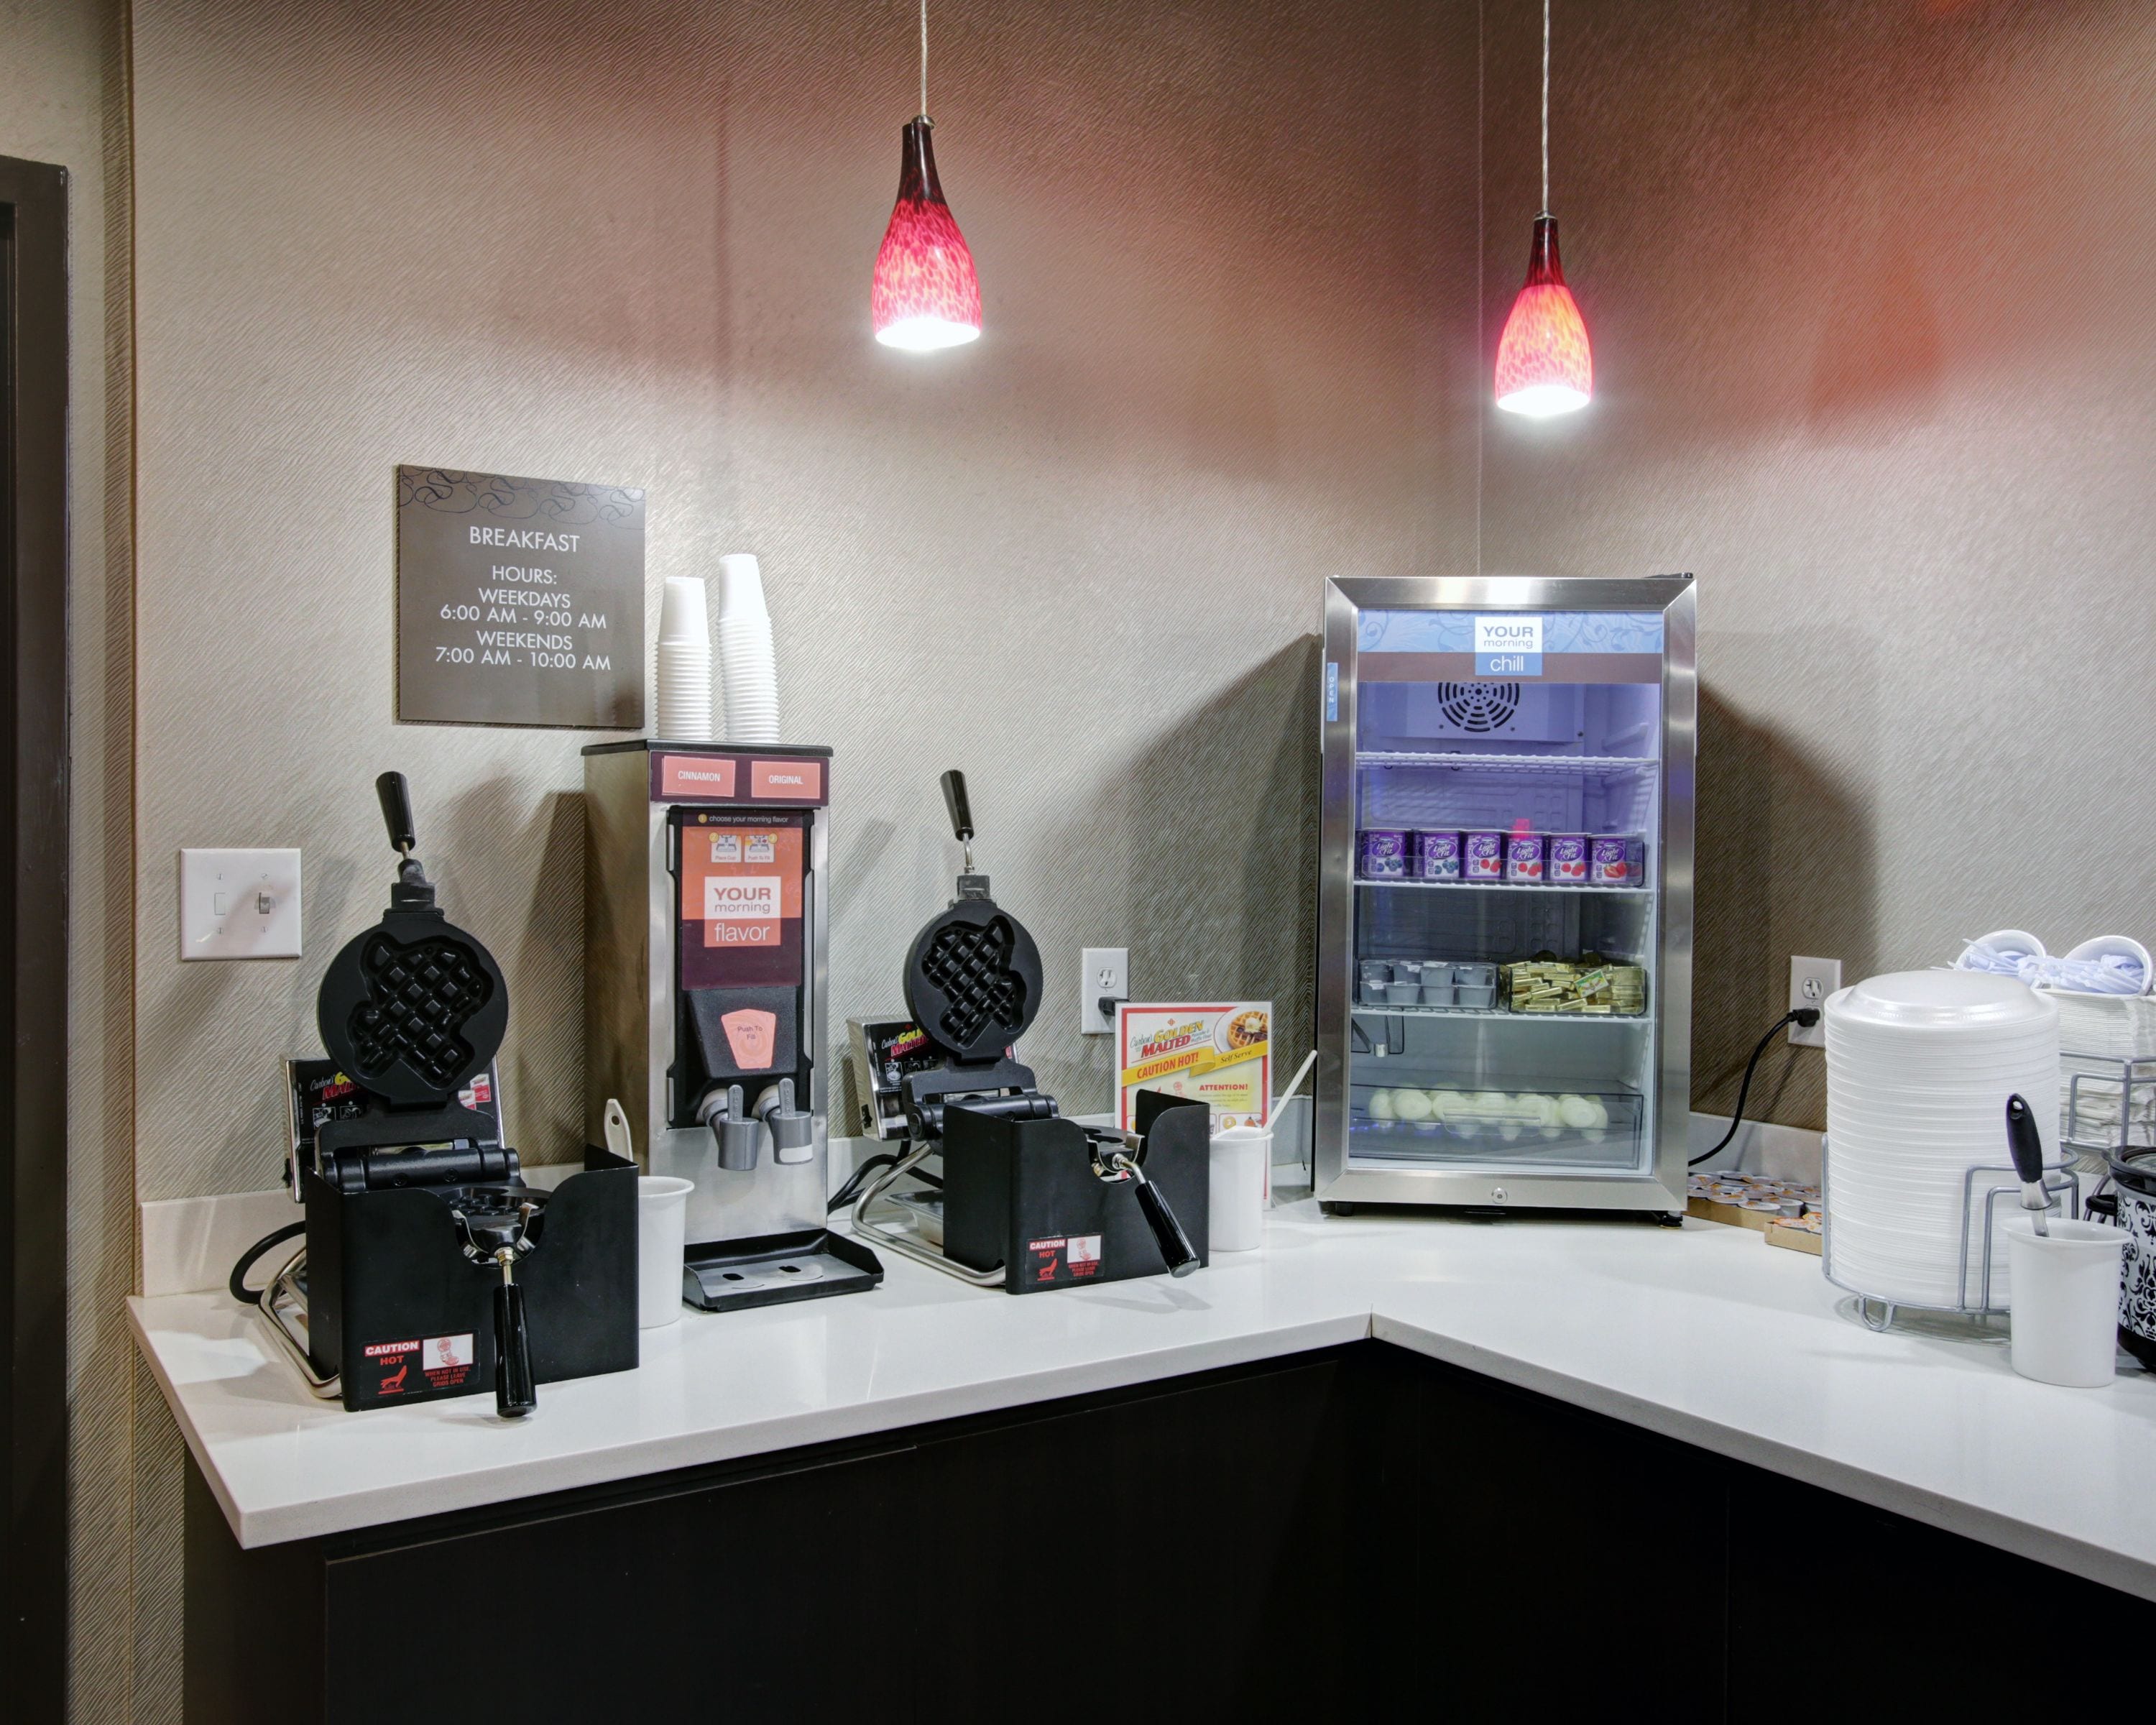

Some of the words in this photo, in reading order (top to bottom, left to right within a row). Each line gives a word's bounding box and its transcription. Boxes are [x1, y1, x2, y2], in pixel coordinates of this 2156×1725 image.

[469, 526, 580, 553] BREAKFAST
[492, 565, 558, 585] HOURS:
[478, 587, 571, 609] WEEKDAYS
[440, 604, 480, 621] 6:00
[487, 607, 517, 624] AM
[533, 610, 572, 627] 9:00
[578, 612, 607, 630] AM
[1483, 626, 1534, 638] YOUR
[476, 630, 573, 650] WEEKENDS
[1483, 638, 1534, 650] morning
[435, 646, 474, 663] 7:00
[481, 649, 511, 666] AM
[530, 651, 576, 669] 10:00
[582, 655, 611, 671] AM
[1490, 655, 1524, 672] chill
[678, 770, 721, 782] CINNAMON
[768, 774, 803, 786] ORIGINAL
[1376, 842, 1394, 852] Light
[1433, 844, 1451, 854] Light
[1478, 842, 1496, 852] Light
[1516, 845, 1534, 856] Light
[1560, 845, 1577, 856] Light
[1601, 847, 1619, 857] Light
[714, 887, 771, 901] YOUR
[714, 901, 770, 914] morning
[714, 922, 770, 942] flavor
[1153, 1020, 1204, 1043] GOLDEN
[1141, 1034, 1191, 1058] MALTED
[1220, 1054, 1233, 1064] Self
[1233, 1049, 1252, 1059] Serve
[1137, 1059, 1176, 1080] CAUTION
[1178, 1052, 1199, 1067] HOT!
[1029, 1239, 1066, 1250] CAUTION
[1038, 1250, 1056, 1259] HOT
[364, 1342, 420, 1356] CAUTION
[379, 1355, 405, 1366] HOT
